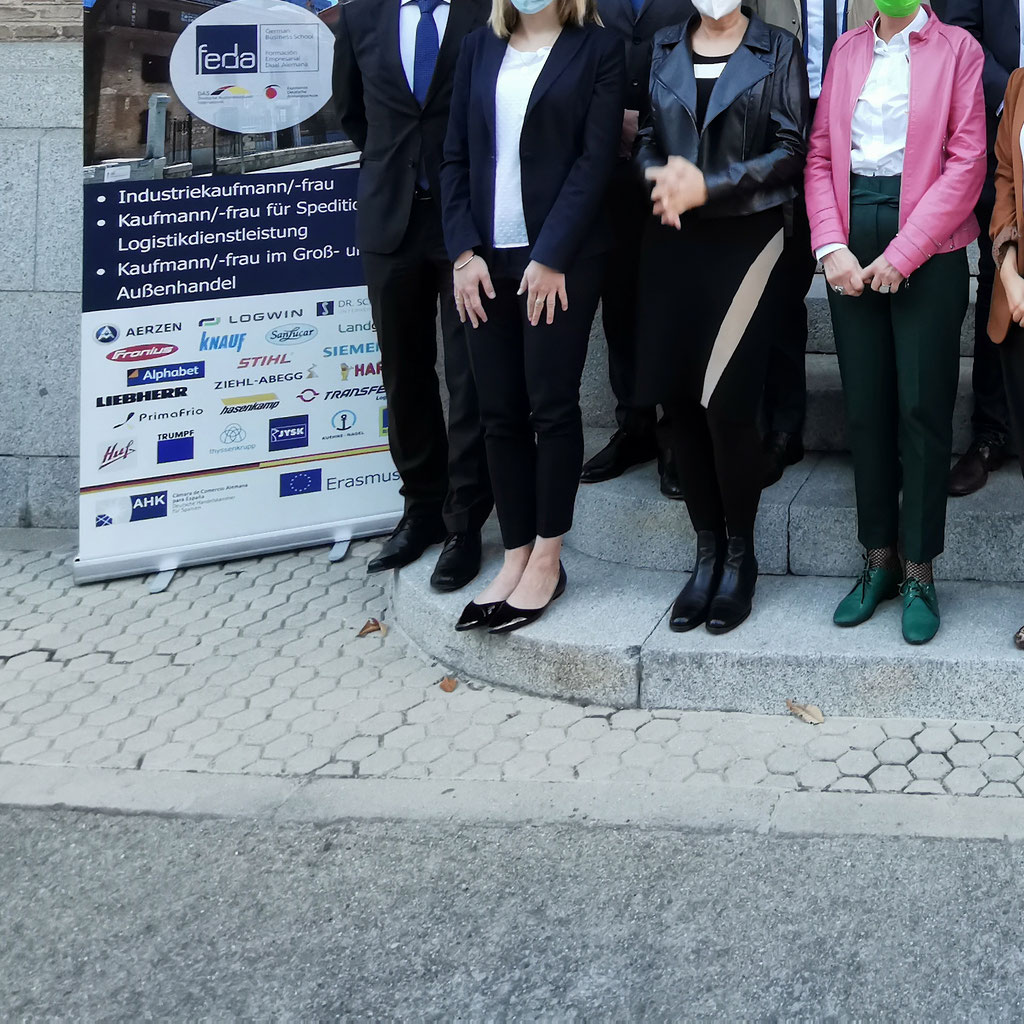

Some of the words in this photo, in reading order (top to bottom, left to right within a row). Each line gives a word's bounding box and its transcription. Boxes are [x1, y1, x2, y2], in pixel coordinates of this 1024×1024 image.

[198, 42, 256, 74] feda
[118, 178, 334, 204] Industriekaufmann/-frau
[118, 205, 261, 228] Kaufmann/-frau
[266, 202, 291, 217] für
[118, 226, 308, 253] Logistikdienstleistung
[118, 252, 260, 277] Kaufmann/-frau
[266, 249, 287, 264] im
[293, 244, 340, 261] Groß-
[116, 275, 236, 301] Außenhandel
[229, 308, 304, 324] LOGWIN
[126, 322, 182, 337] AERZEN
[111, 346, 174, 360] Fronius
[237, 353, 292, 369] STIHL
[142, 366, 199, 382] Alphabet
[214, 371, 303, 390] ZIEHL-ABEGG
[96, 386, 188, 408] LIEBHERR
[219, 401, 280, 416] hasenkamp
[157, 429, 195, 441] TRUMPF
[277, 426, 305, 438] JYSK
[101, 439, 136, 465] Huf
[326, 470, 401, 491] Erasmus
[133, 494, 166, 509] AHK
